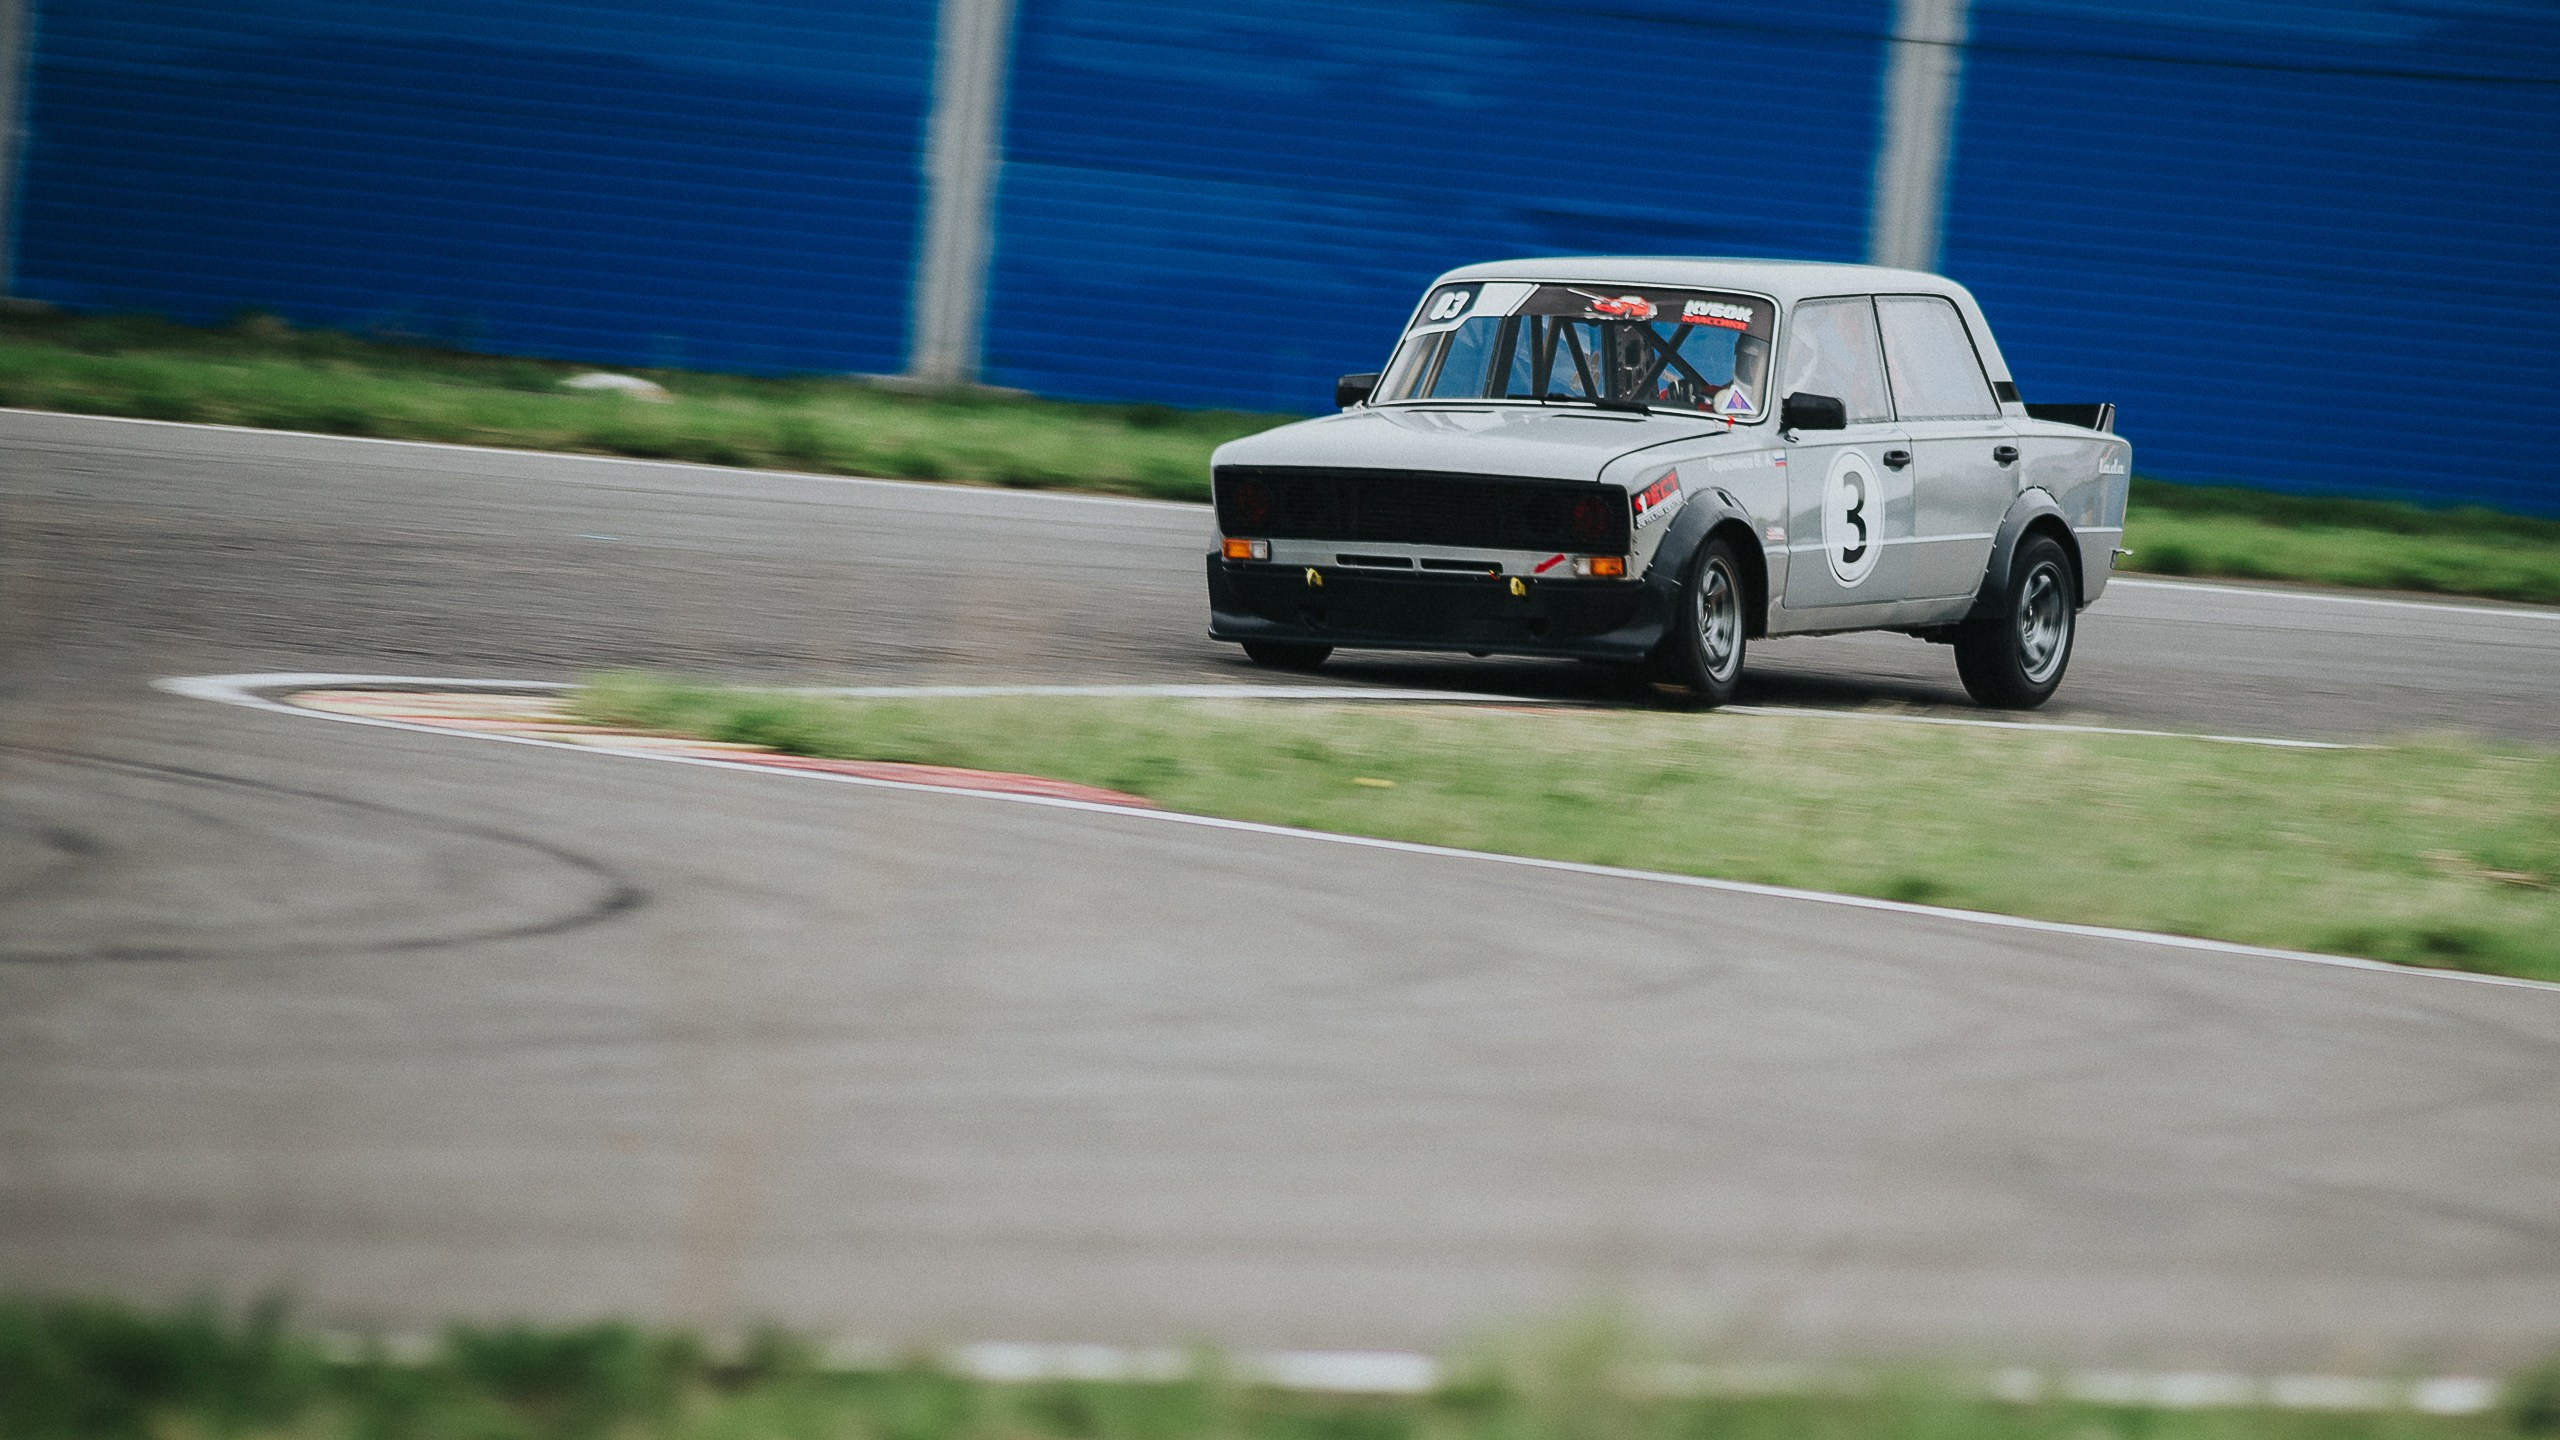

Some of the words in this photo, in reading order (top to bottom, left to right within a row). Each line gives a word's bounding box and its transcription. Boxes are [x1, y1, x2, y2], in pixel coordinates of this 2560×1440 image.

[1430, 291, 1470, 320] 03
[1683, 300, 1753, 323] КУБОК
[1842, 470, 1867, 564] 3
